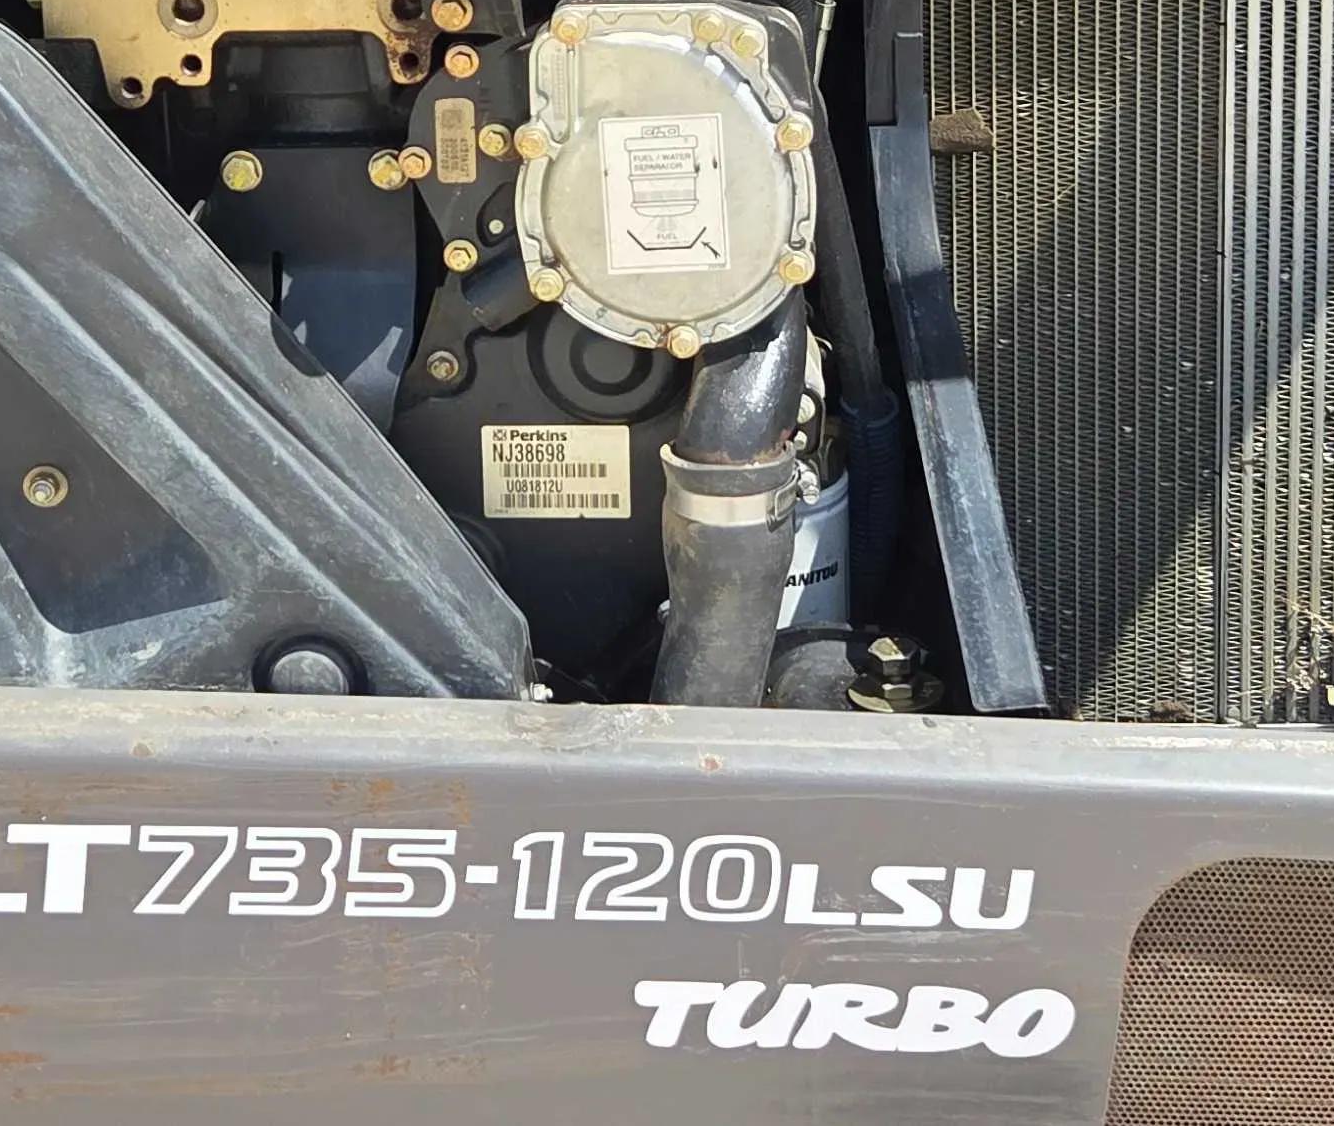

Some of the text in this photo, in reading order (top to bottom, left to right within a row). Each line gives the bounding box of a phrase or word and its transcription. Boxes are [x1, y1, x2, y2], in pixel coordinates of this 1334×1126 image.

[657, 233, 678, 241] FUEL
[510, 429, 567, 441] Perkins
[493, 443, 565, 462] NJ38698
[507, 479, 563, 493] U081812U
[784, 561, 839, 588] ANITOU
[634, 980, 1076, 1058] TURBO
